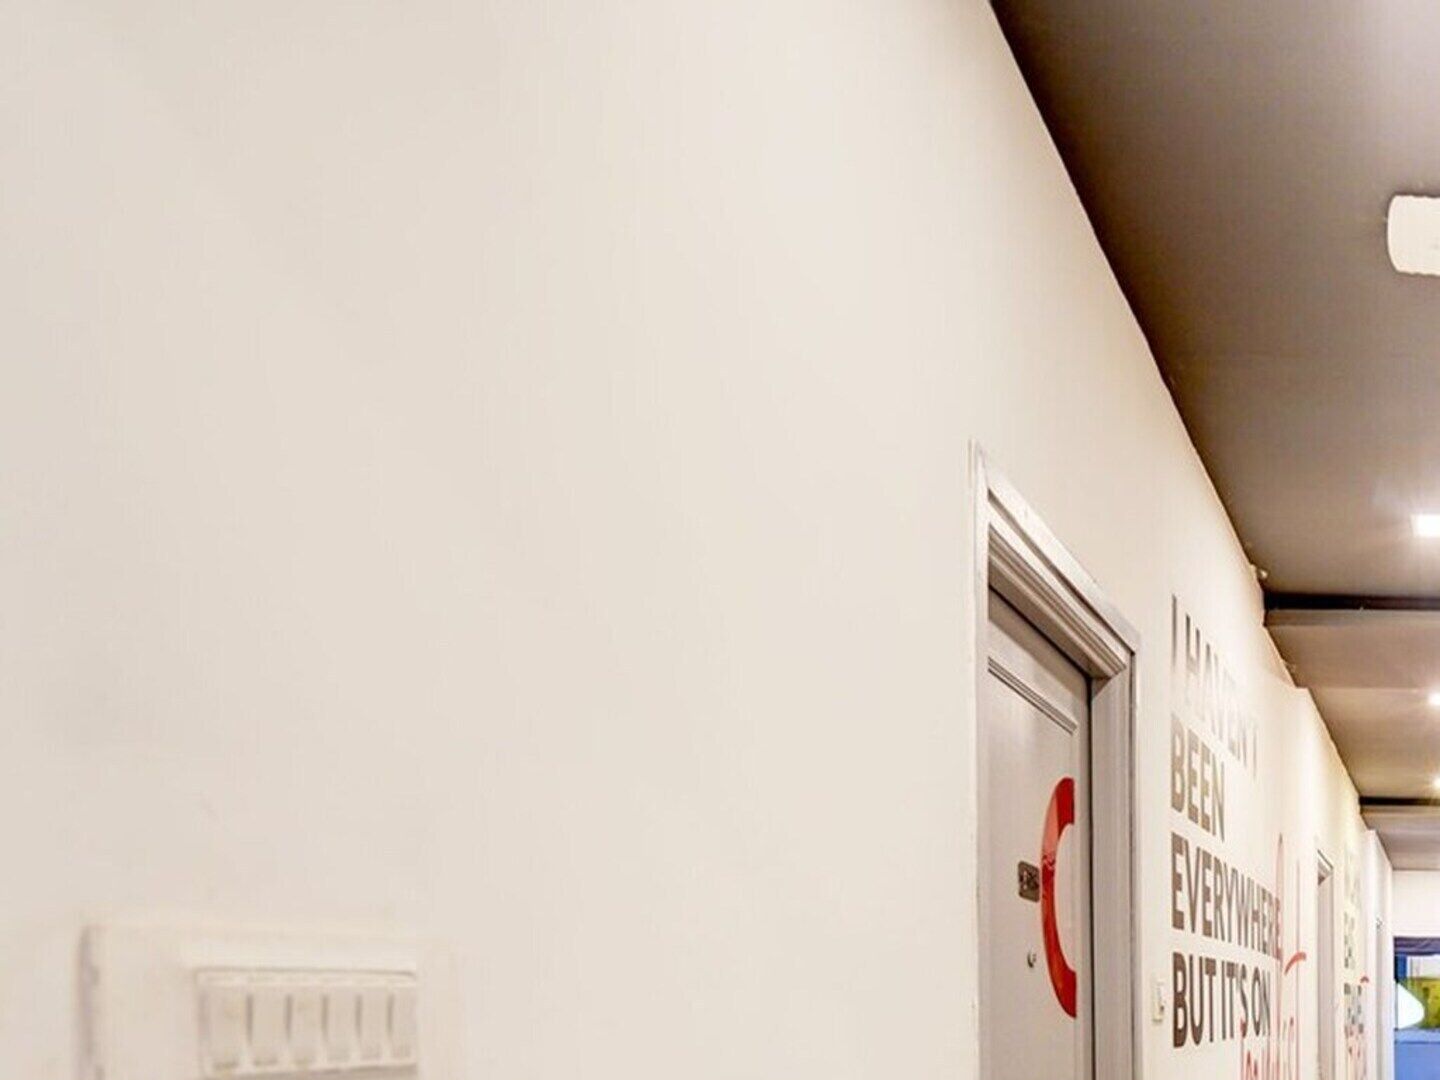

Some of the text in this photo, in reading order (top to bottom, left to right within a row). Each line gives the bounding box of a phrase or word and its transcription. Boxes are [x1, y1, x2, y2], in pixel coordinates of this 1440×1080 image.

[1185, 614, 1259, 779] HAVENT
[1171, 713, 1226, 842] BEEN
[1172, 951, 1272, 1049] BUT IT'S ON
